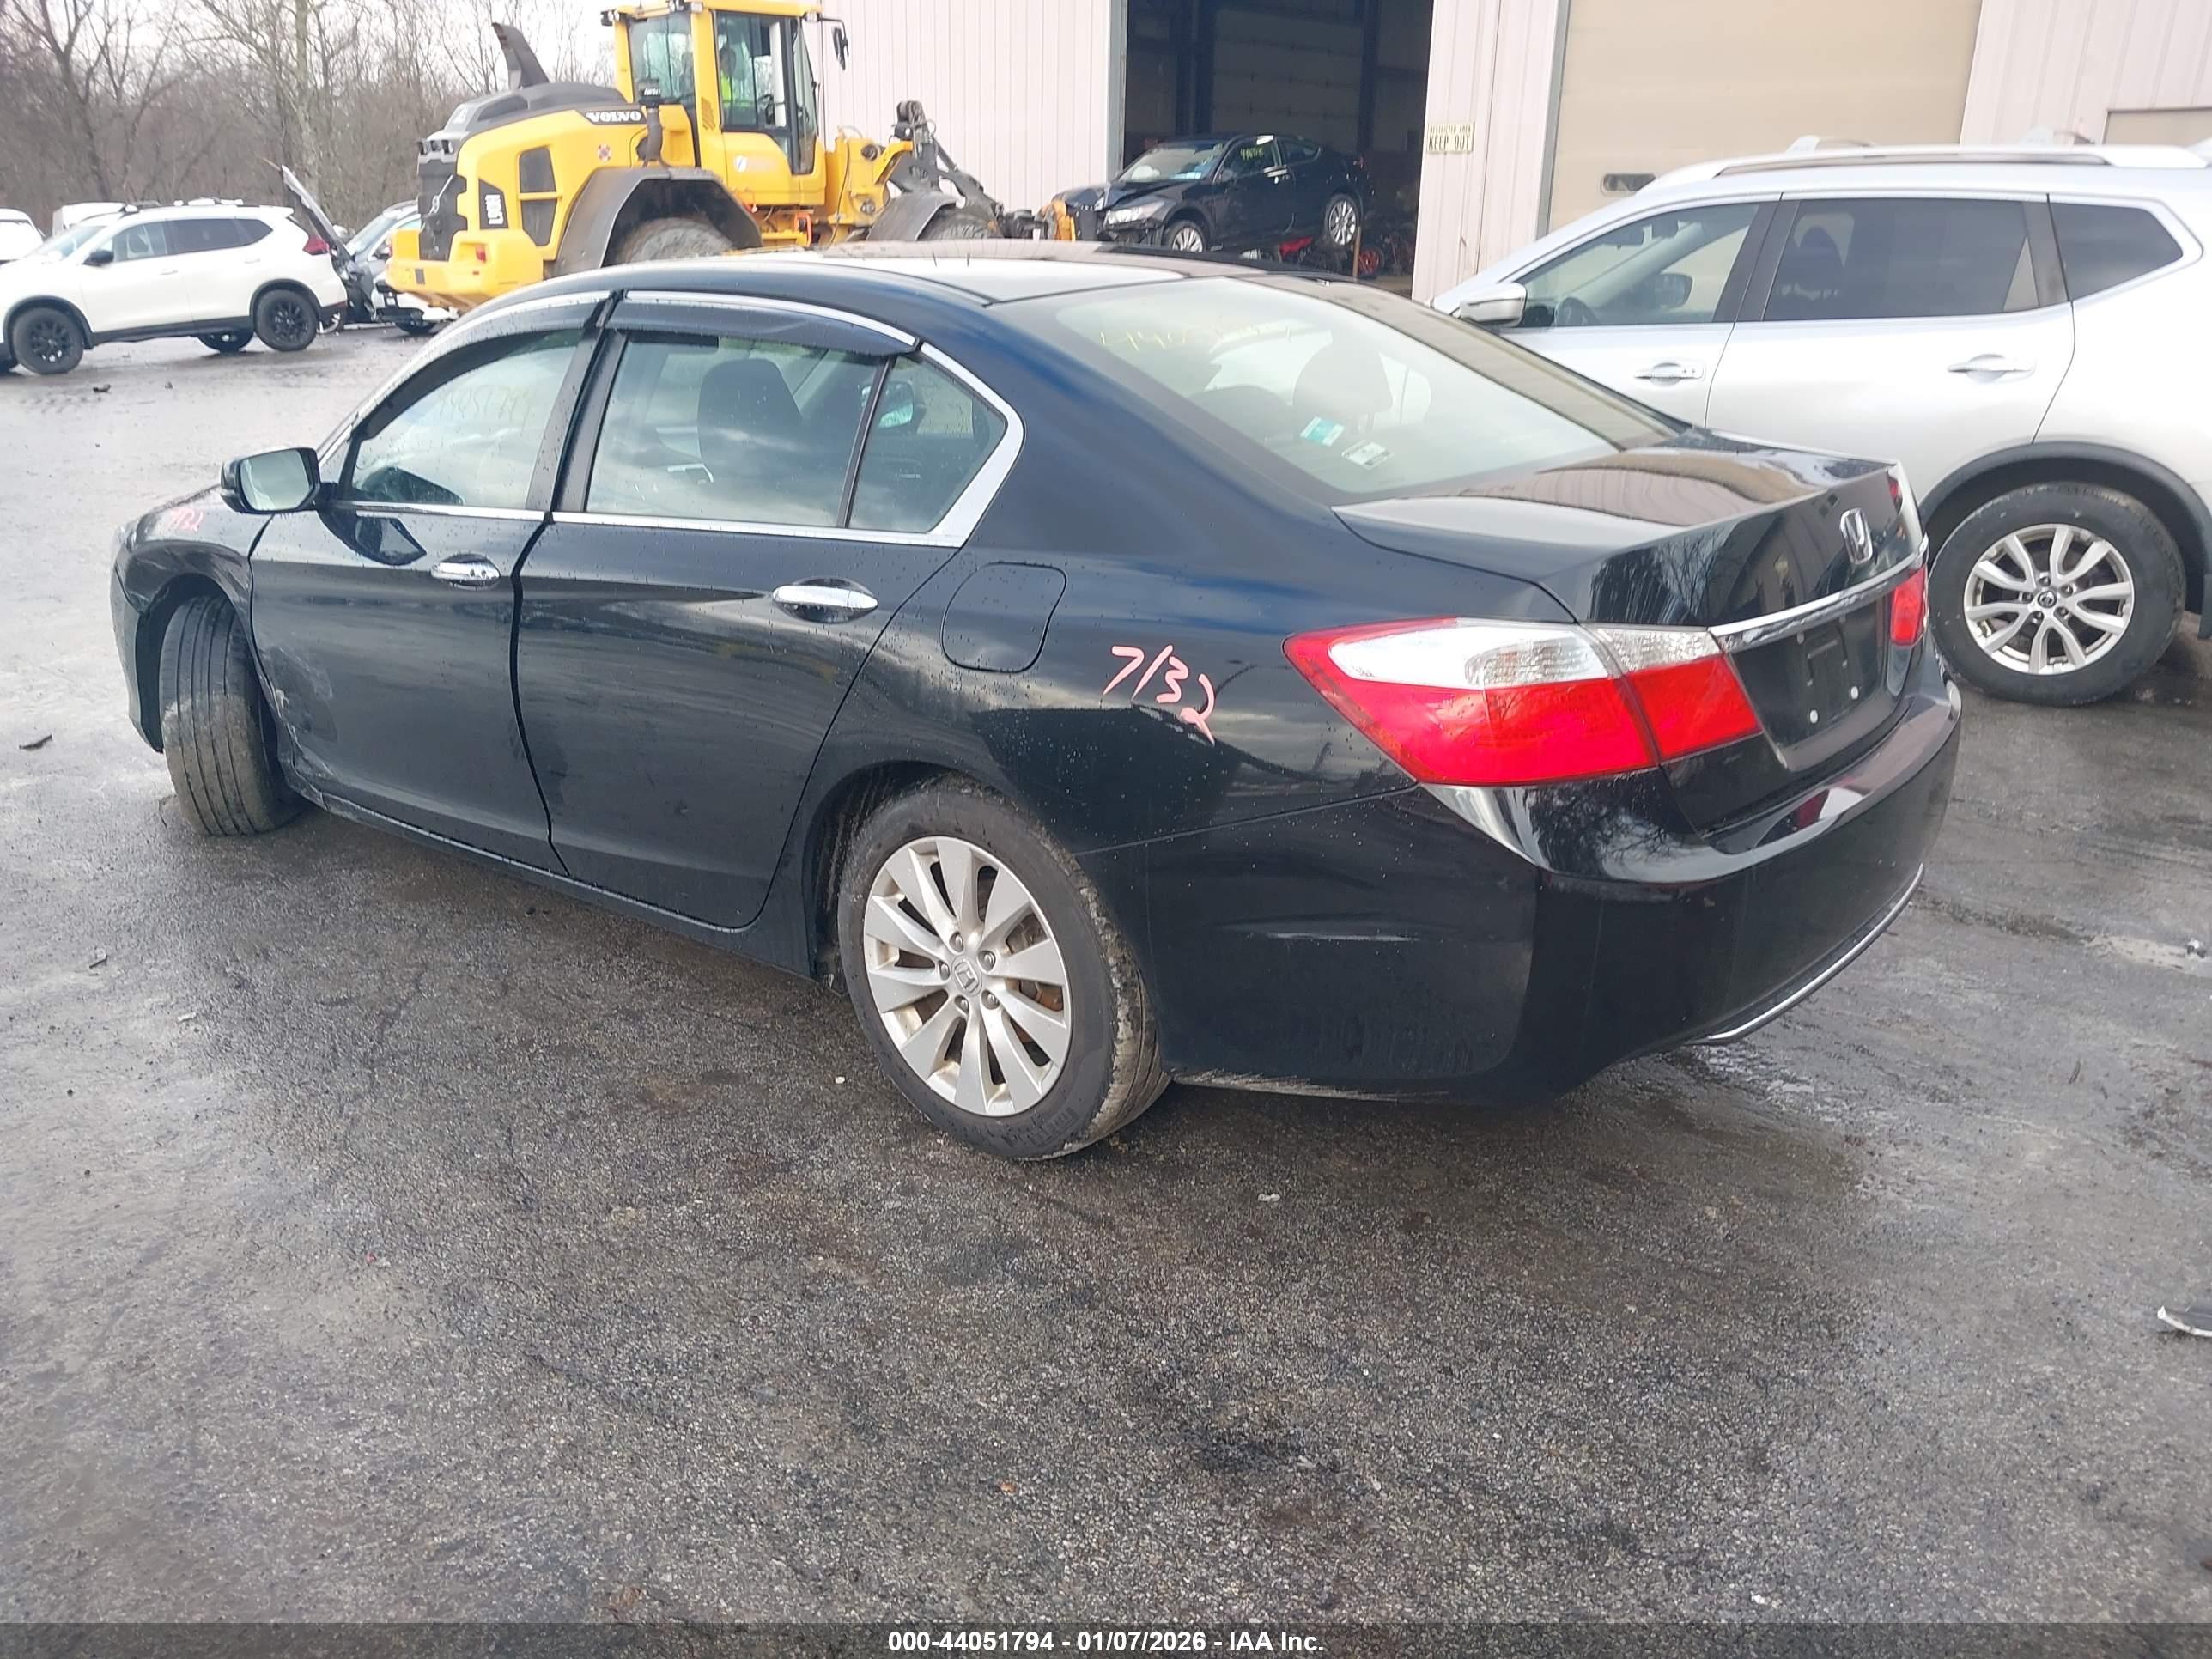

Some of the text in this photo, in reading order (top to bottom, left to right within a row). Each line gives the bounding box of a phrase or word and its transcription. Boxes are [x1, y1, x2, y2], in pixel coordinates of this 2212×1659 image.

[586, 110, 641, 122] VOLVO
[1428, 135, 1470, 151] KEEP OUT
[1103, 644, 1216, 747] 7/32
